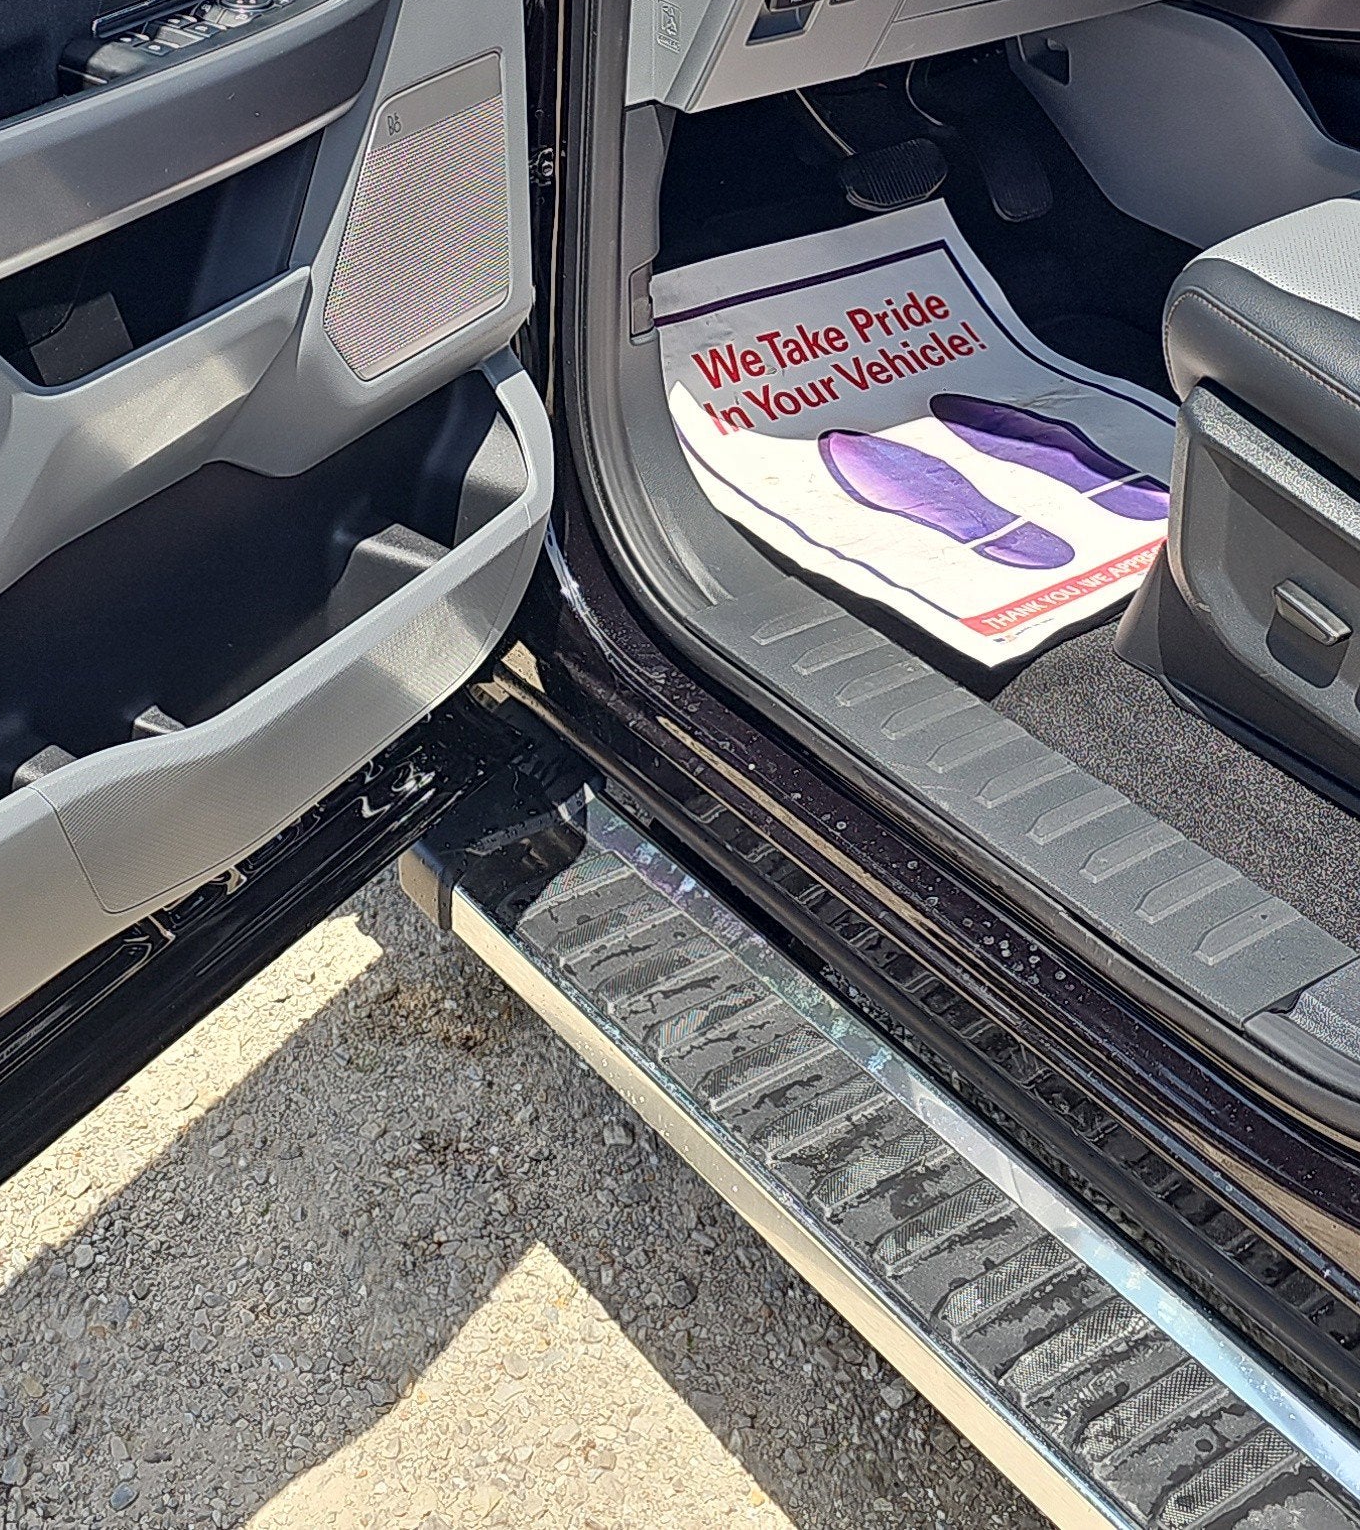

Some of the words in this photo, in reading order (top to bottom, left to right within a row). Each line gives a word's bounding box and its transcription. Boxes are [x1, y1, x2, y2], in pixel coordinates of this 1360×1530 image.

[691, 343, 766, 389] We
[756, 324, 849, 369] Take
[846, 291, 951, 343] Pride
[702, 402, 755, 436] In
[742, 374, 840, 421] Your
[832, 321, 987, 391] Vehicle!
[981, 599, 1047, 630] THANK
[1038, 585, 1089, 605] YOU,
[1076, 571, 1113, 588] WE
